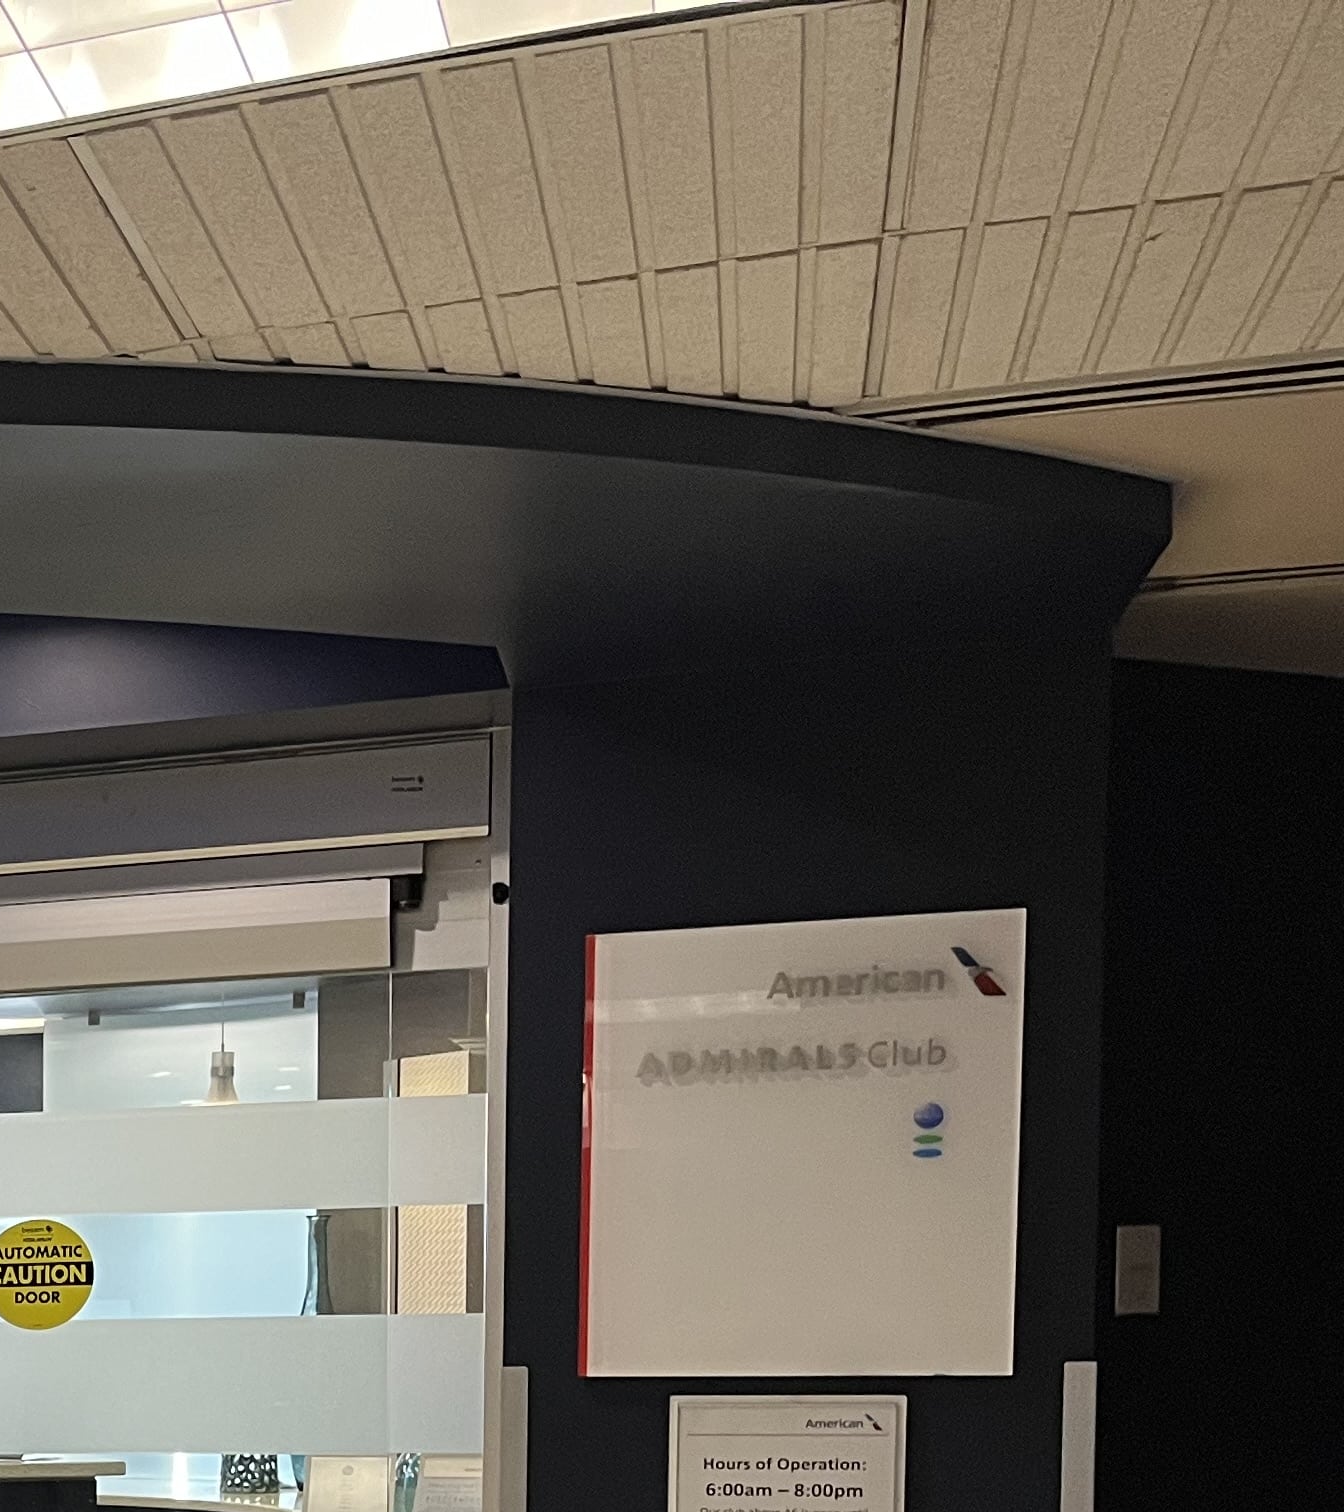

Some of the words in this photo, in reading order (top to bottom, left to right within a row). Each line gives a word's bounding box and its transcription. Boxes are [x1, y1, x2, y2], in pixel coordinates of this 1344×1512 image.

[767, 965, 945, 999] American
[635, 1043, 857, 1081] ADMIRALS
[868, 1038, 947, 1068] Club
[14, 1291, 61, 1304] DOOR
[805, 1418, 864, 1429] American
[703, 1458, 751, 1471] Hours
[755, 1457, 772, 1471] of
[777, 1458, 868, 1473] Operation:
[705, 1483, 772, 1497] 6:00am
[794, 1483, 864, 1500] 8:00pm
